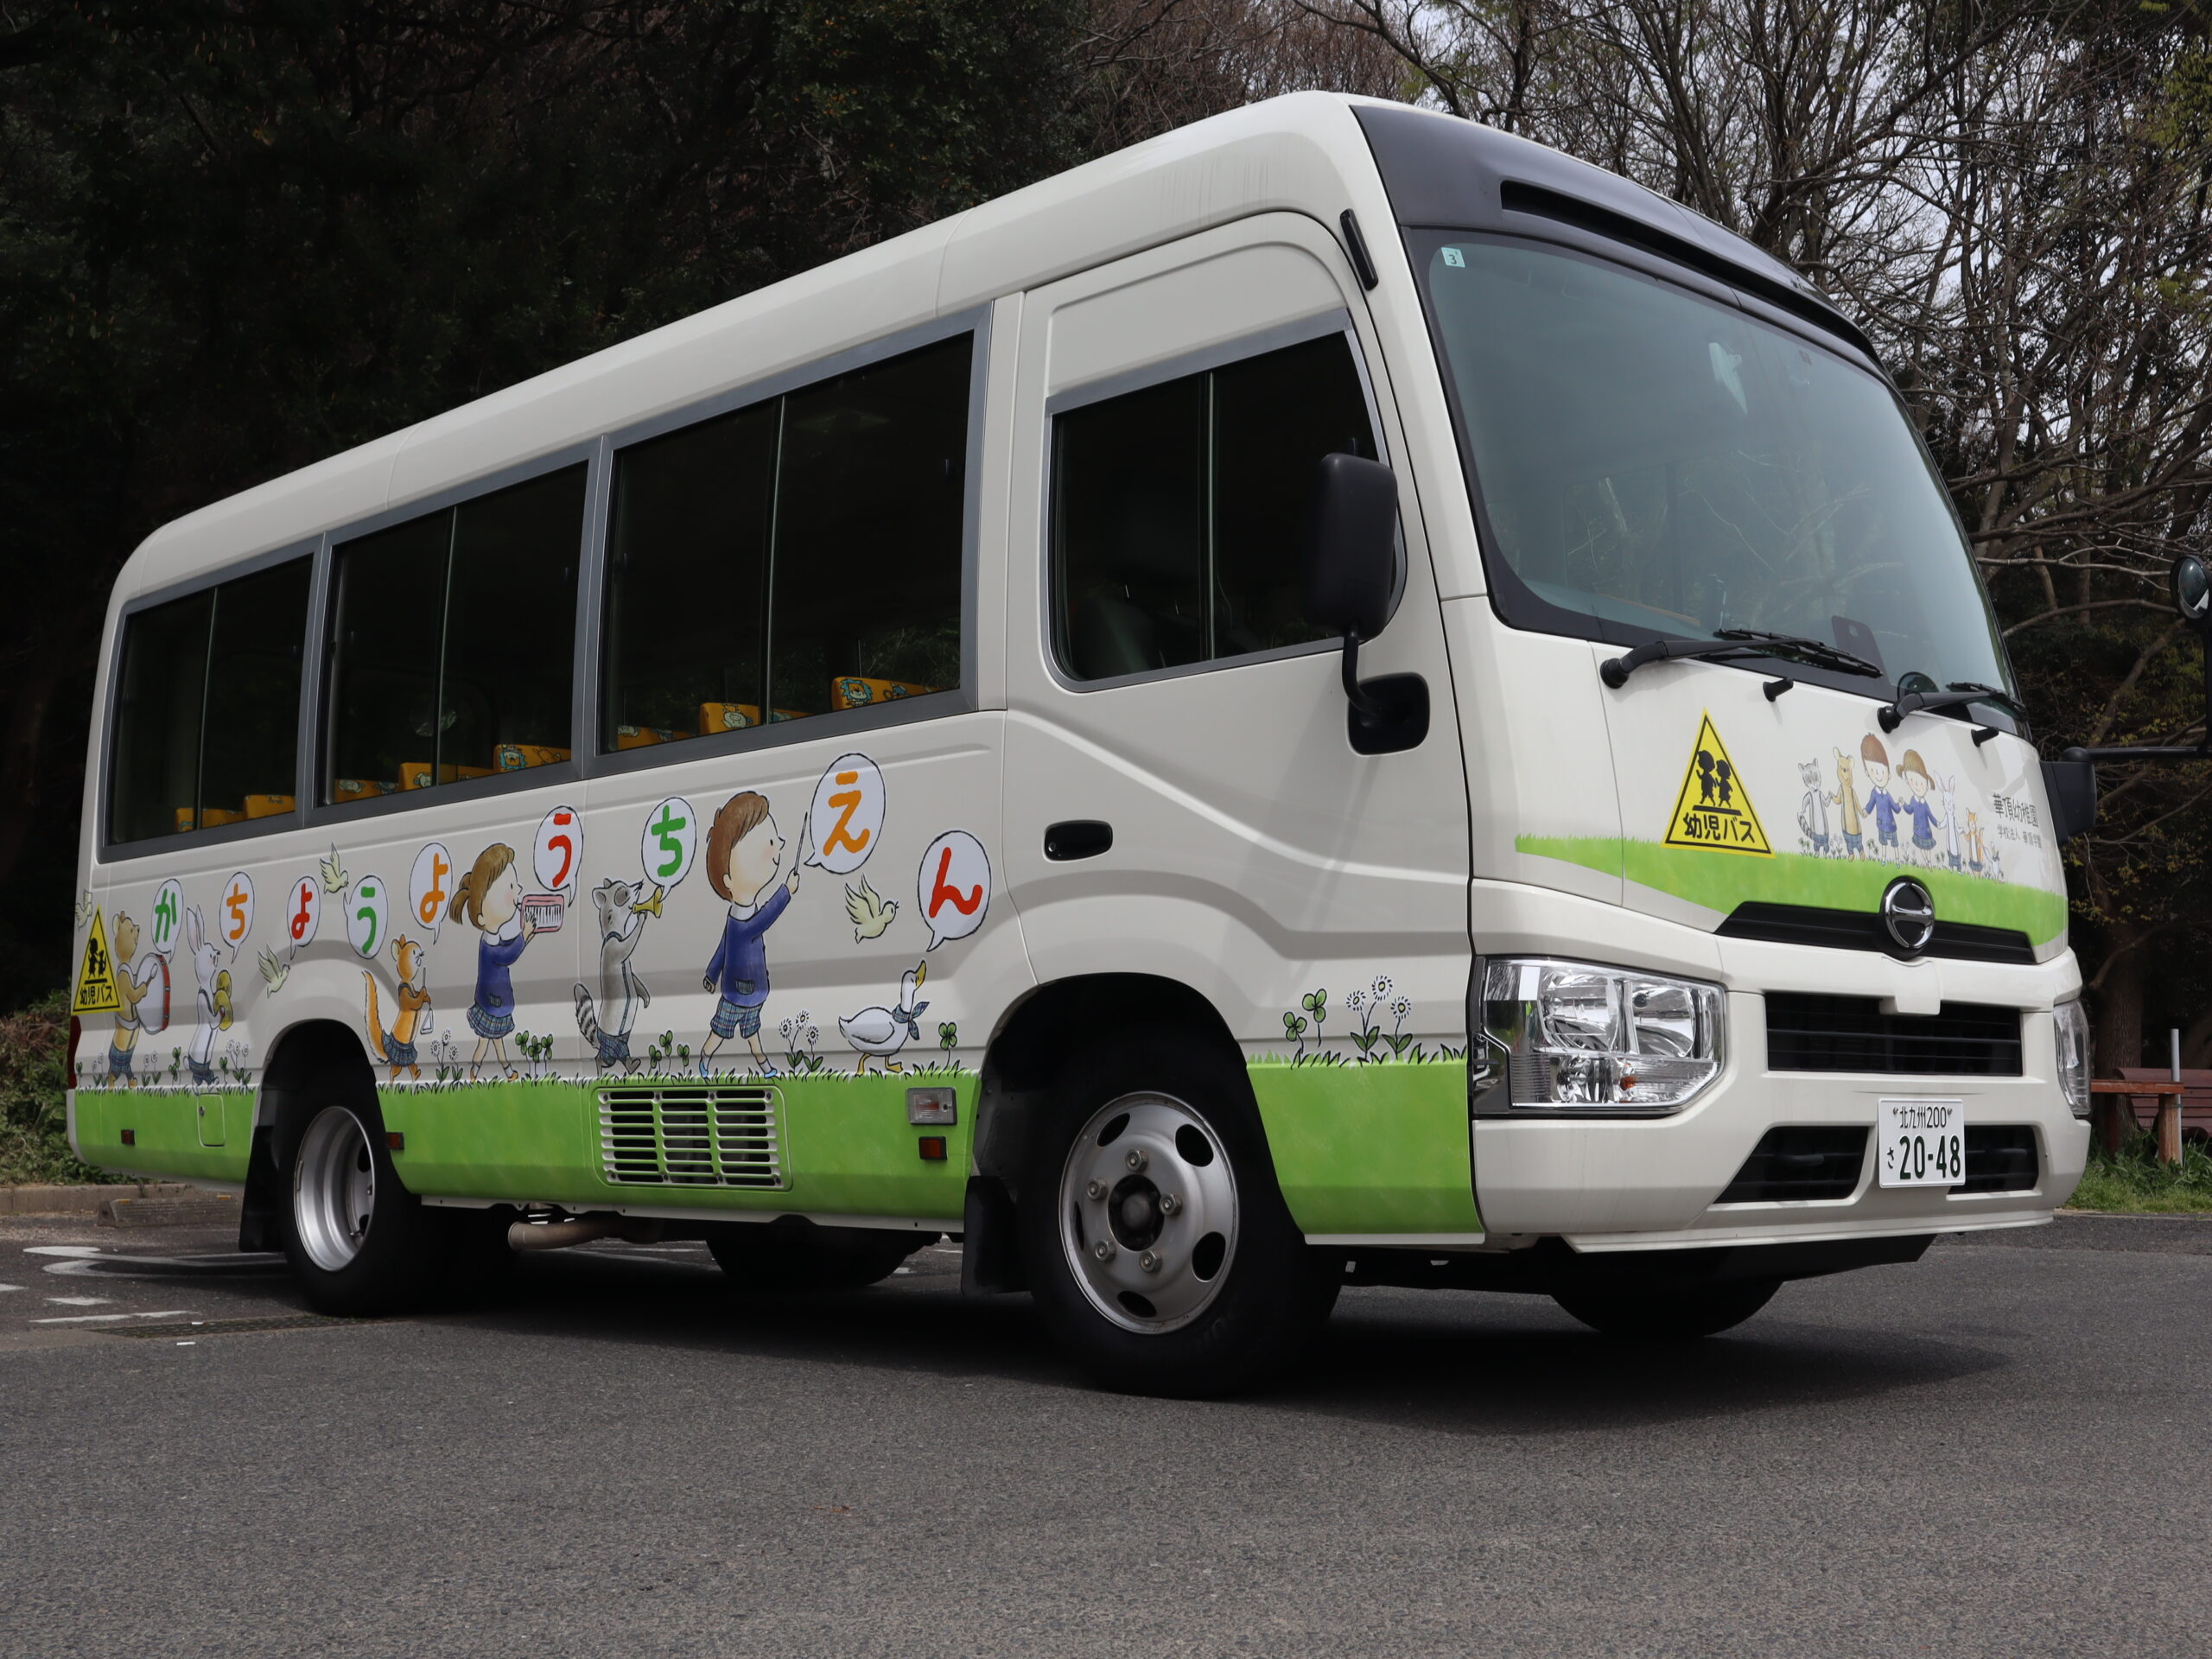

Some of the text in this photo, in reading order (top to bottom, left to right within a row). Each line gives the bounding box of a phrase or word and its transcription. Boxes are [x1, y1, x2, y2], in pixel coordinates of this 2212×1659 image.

[1448, 254, 1457, 264] 3
[1993, 793, 2039, 828] 華頂幼稚園
[1682, 812, 1756, 843] 幼児バス
[1997, 823, 2021, 841] 学校法人
[155, 888, 176, 942] か
[226, 883, 248, 940] ち
[358, 887, 377, 953] う
[419, 852, 448, 924] よ
[548, 812, 572, 888] う
[651, 805, 686, 877] ち
[823, 771, 871, 856] え
[928, 846, 983, 918] ん
[79, 984, 113, 1006] 幼児バス
[1886, 1135, 1961, 1179] さ 20-48
